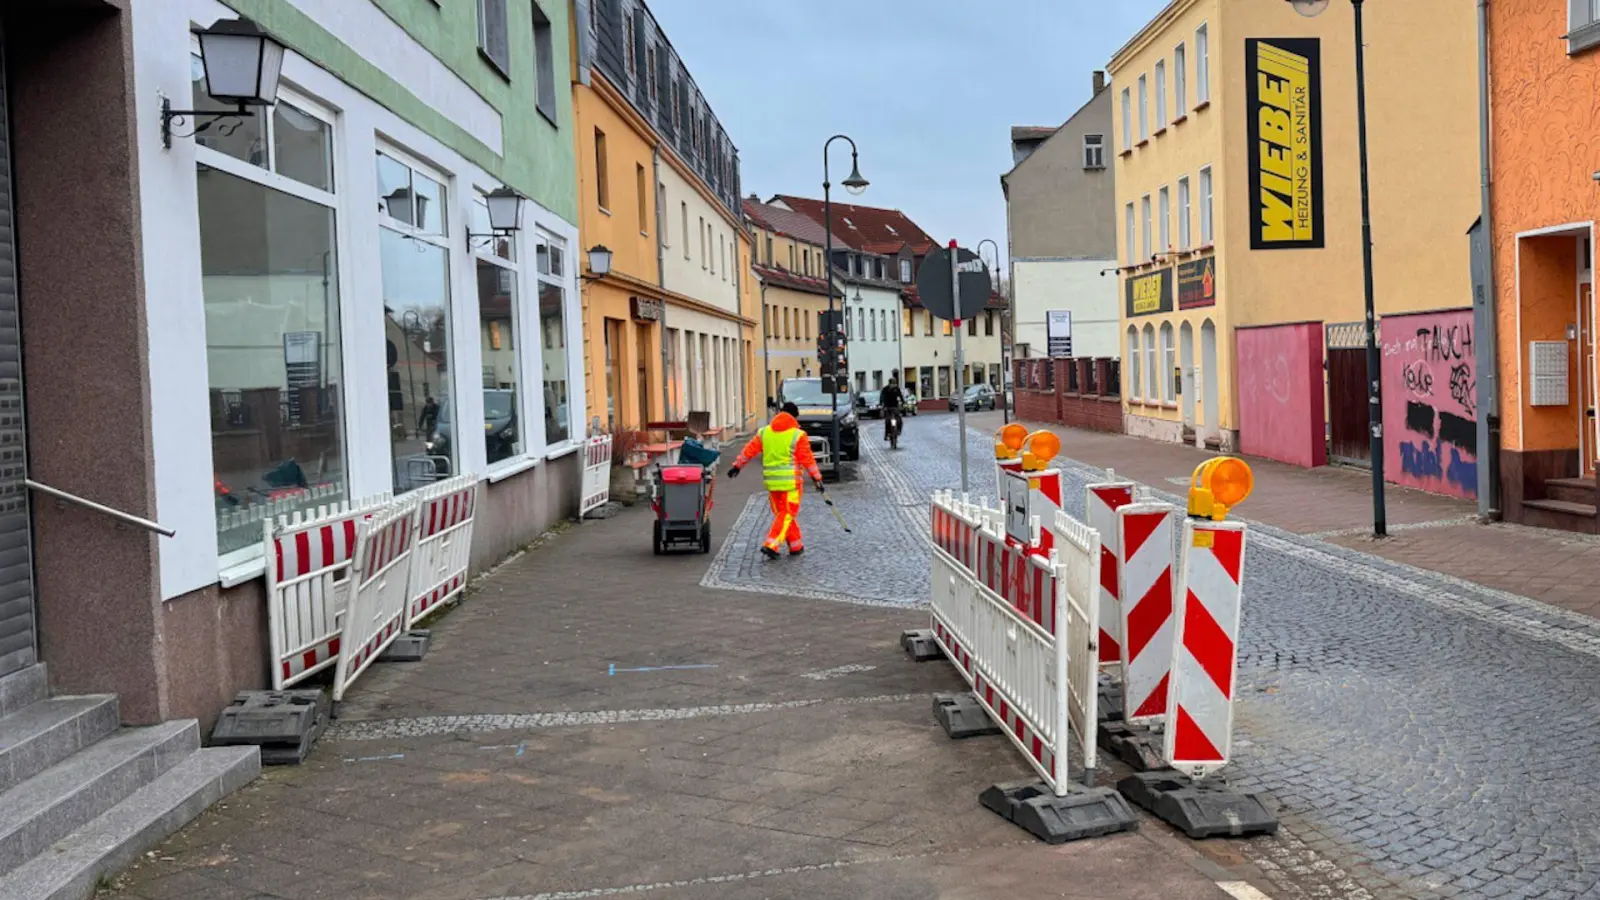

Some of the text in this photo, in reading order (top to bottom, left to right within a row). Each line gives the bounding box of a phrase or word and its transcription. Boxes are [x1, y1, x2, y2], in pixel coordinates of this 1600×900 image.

[1257, 71, 1294, 241] WIEBE
[1293, 86, 1309, 229] HEIZUNG & SANITÄR
[1416, 323, 1472, 363] TAUCH
